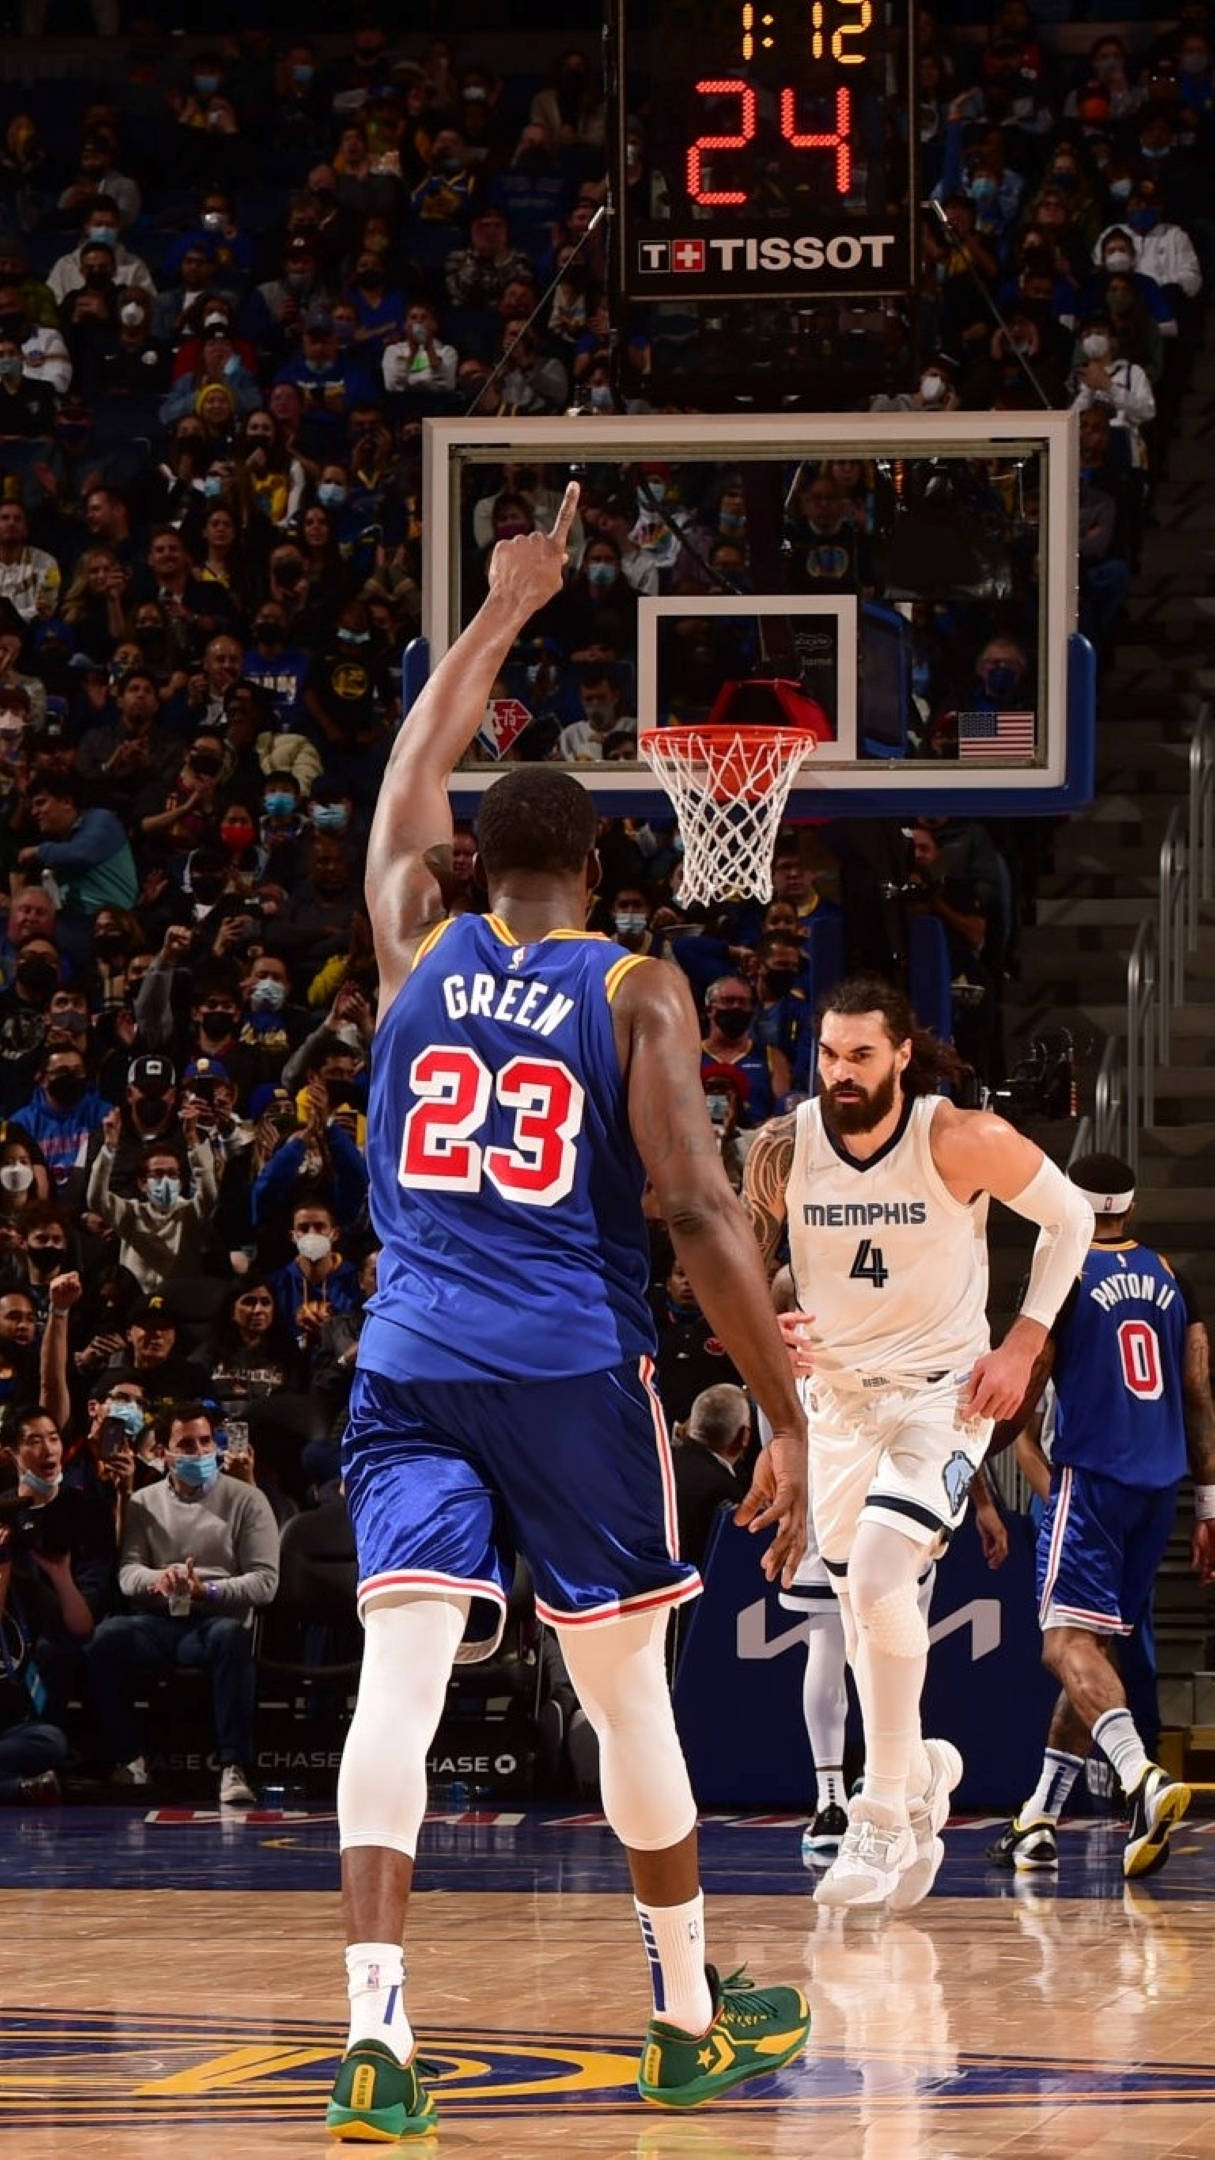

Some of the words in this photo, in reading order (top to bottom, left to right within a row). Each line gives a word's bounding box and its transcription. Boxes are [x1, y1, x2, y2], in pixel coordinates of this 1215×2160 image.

[742, 0, 872, 64] 1:12
[687, 80, 850, 205] 24
[709, 235, 895, 271] TISSOT
[443, 973, 575, 1037] GREEN
[398, 1044, 586, 1207] 23
[803, 1202, 927, 1226] MEMPHIS
[849, 1239, 889, 1288] 4
[1090, 1273, 1155, 1311] PAYTON
[1155, 1284, 1176, 1311] II
[1117, 1320, 1164, 1400] 0
[257, 1752, 344, 1768] CHASE
[425, 1756, 490, 1773] HASE
